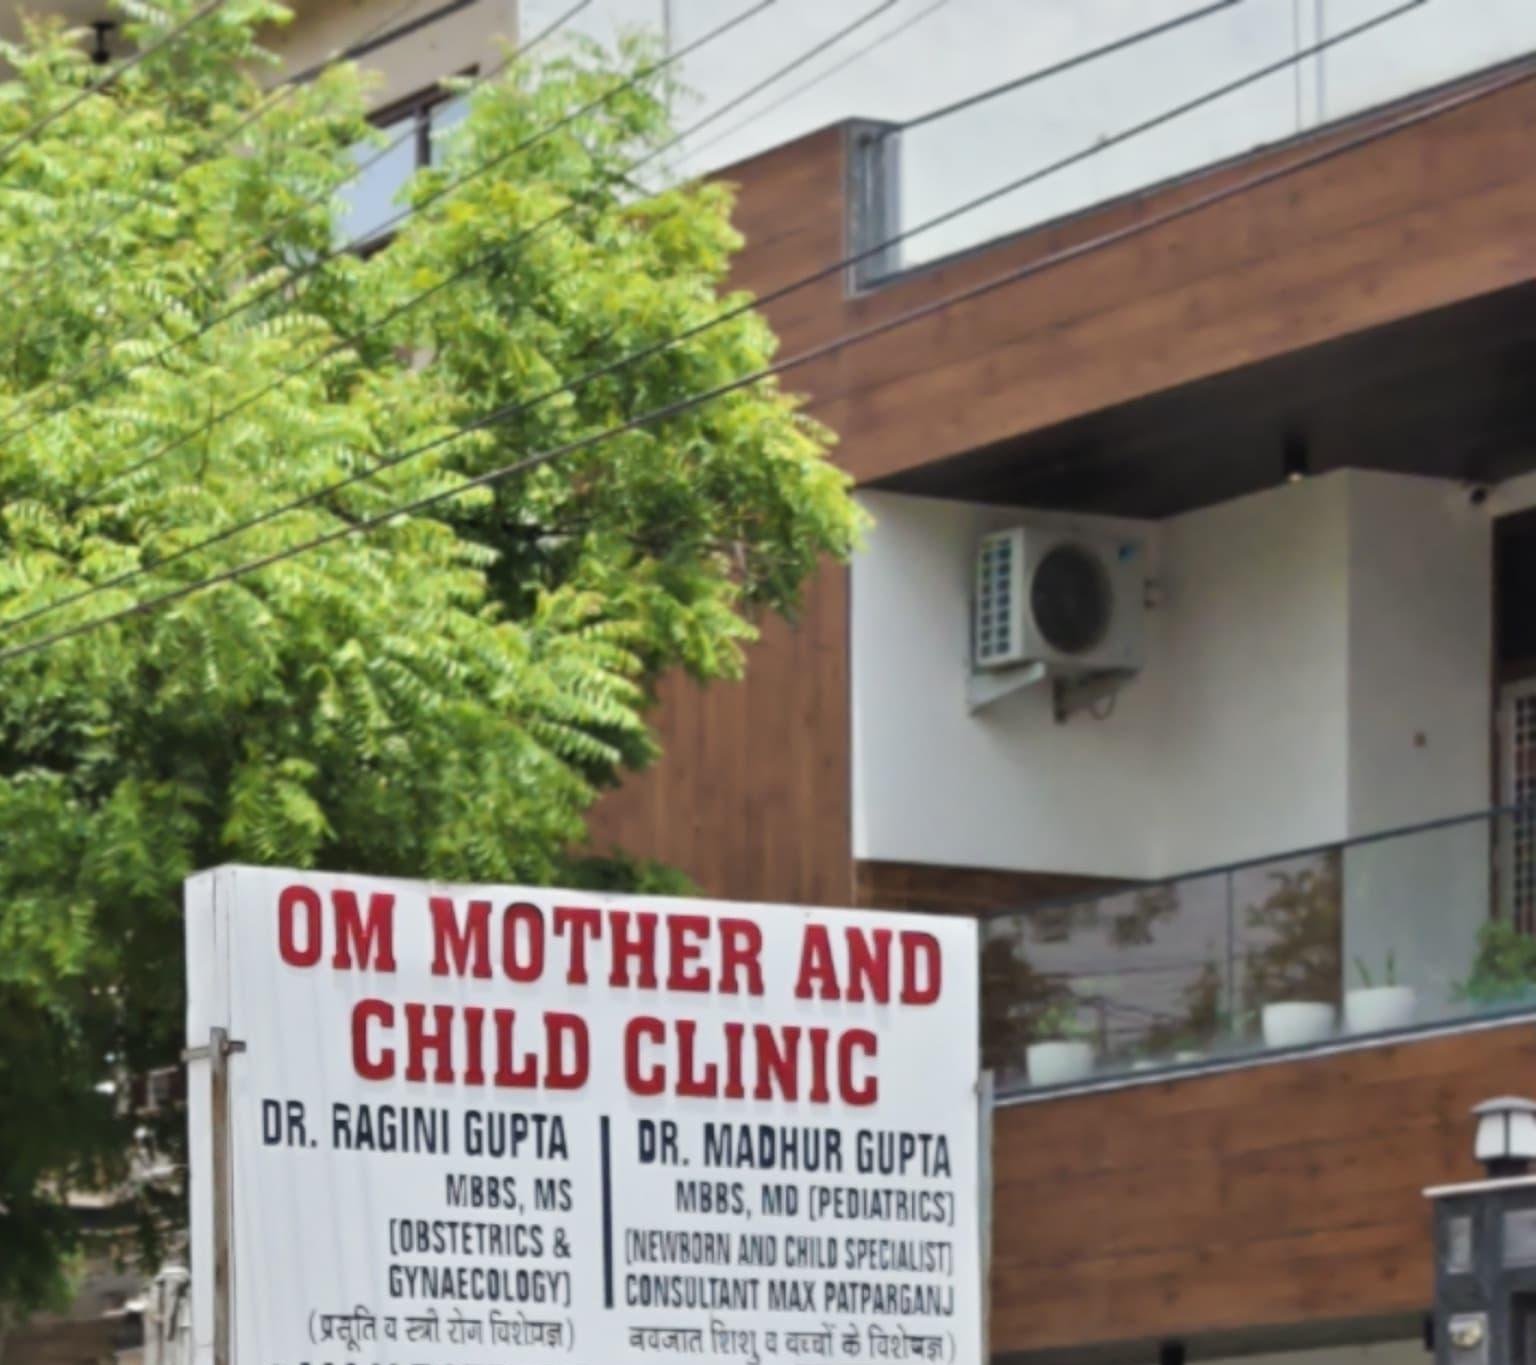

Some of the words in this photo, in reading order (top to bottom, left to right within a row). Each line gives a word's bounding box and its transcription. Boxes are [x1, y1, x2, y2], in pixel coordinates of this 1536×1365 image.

[278, 885, 397, 973] OM
[429, 896, 765, 997] MOTHER
[794, 923, 942, 1006] AND
[351, 998, 590, 1091] CHILD
[624, 1015, 878, 1107] CLINIC
[262, 1098, 318, 1148] DR.
[332, 1102, 450, 1155] RAGINI
[463, 1109, 569, 1160] GUPTA
[638, 1118, 690, 1167] DR.
[703, 1122, 843, 1173] MADHUR
[855, 1129, 952, 1179] GUPTA
[445, 1173, 525, 1216] MBBS,
[534, 1177, 573, 1212] MS
[675, 1179, 752, 1221] MBBS,
[760, 1183, 799, 1217] MD
[552, 1227, 572, 1259] &
[737, 1234, 777, 1267] AND
[784, 1235, 839, 1270] CHILD
[624, 1273, 760, 1311] CONSULTANT
[767, 1279, 816, 1313] MAX
[824, 1281, 955, 1318] PATPARGANJ
